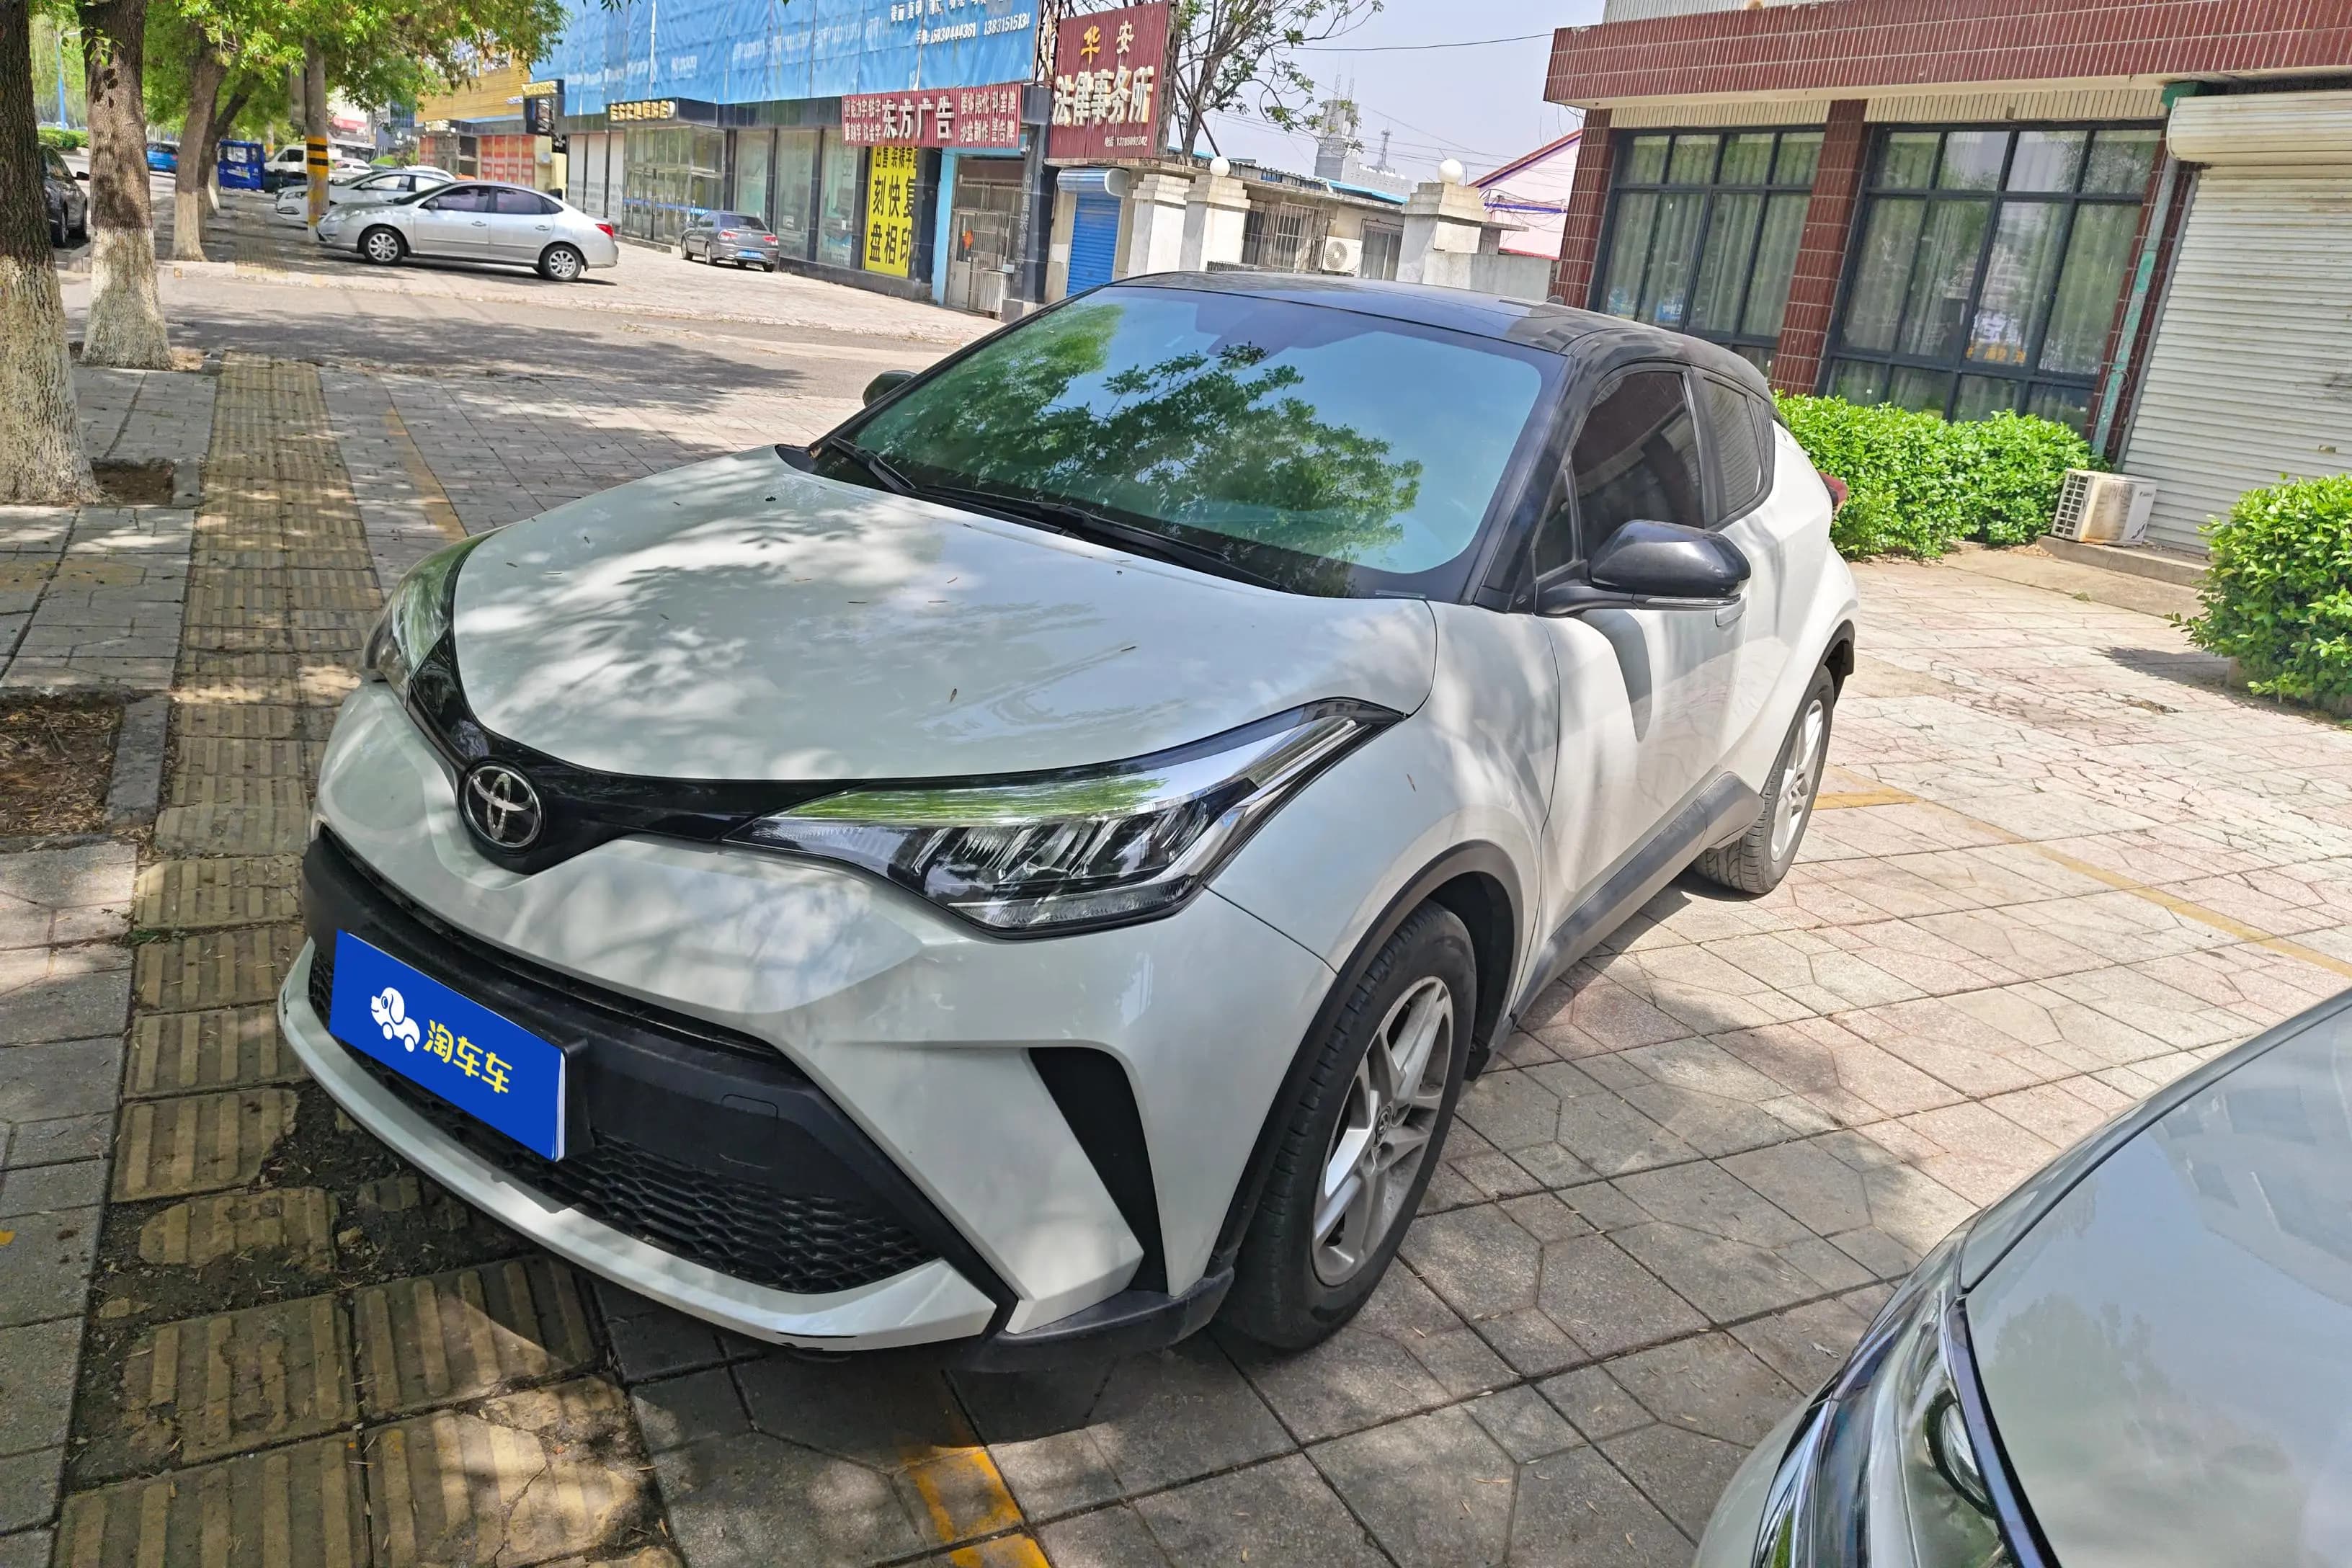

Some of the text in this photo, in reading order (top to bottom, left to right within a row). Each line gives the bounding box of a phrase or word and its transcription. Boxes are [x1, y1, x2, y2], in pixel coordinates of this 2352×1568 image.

[882, 95, 955, 140] 东方广告
[1051, 66, 1154, 127] 法律事务所
